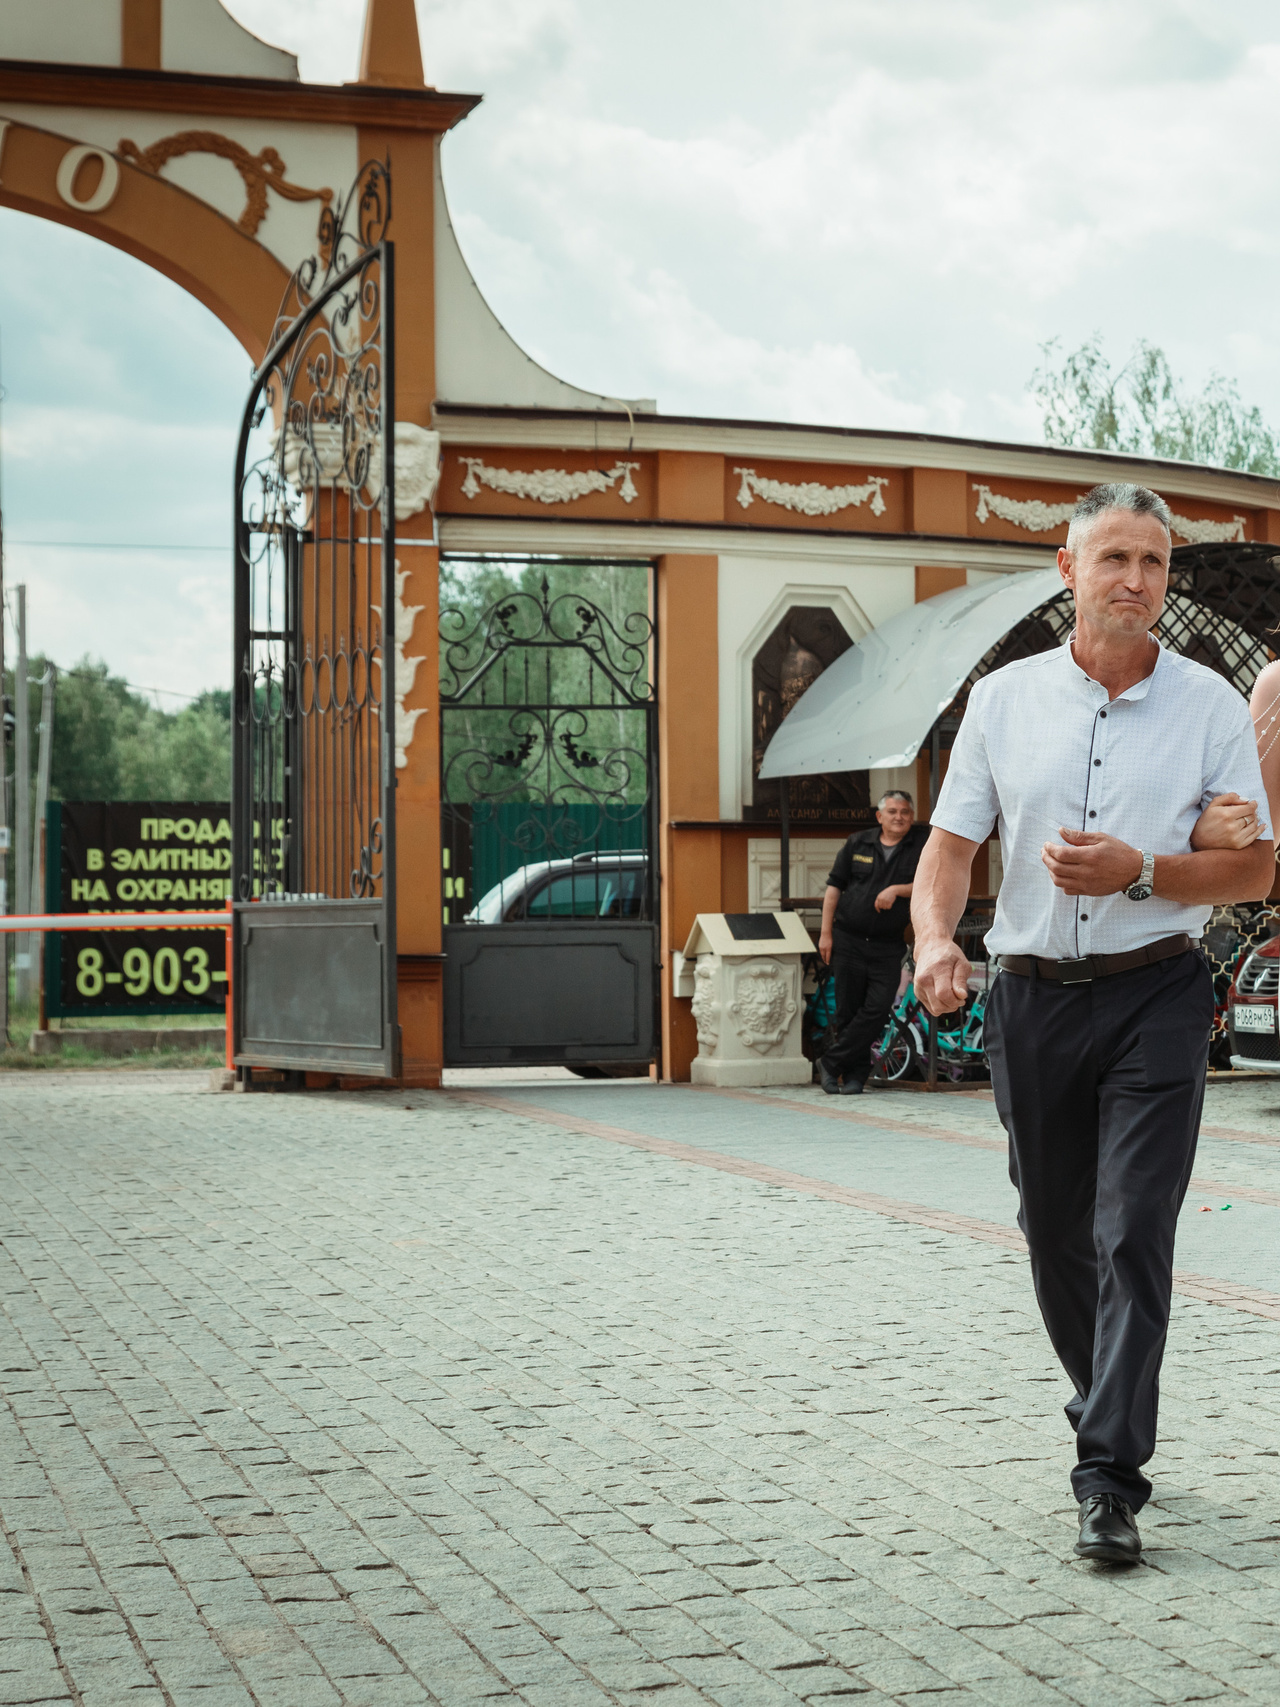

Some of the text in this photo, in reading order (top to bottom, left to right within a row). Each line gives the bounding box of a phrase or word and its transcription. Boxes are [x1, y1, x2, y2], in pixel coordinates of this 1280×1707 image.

[767, 808, 823, 819] АЛСАНДР
[87, 848, 105, 871] В
[71, 879, 112, 901] НА
